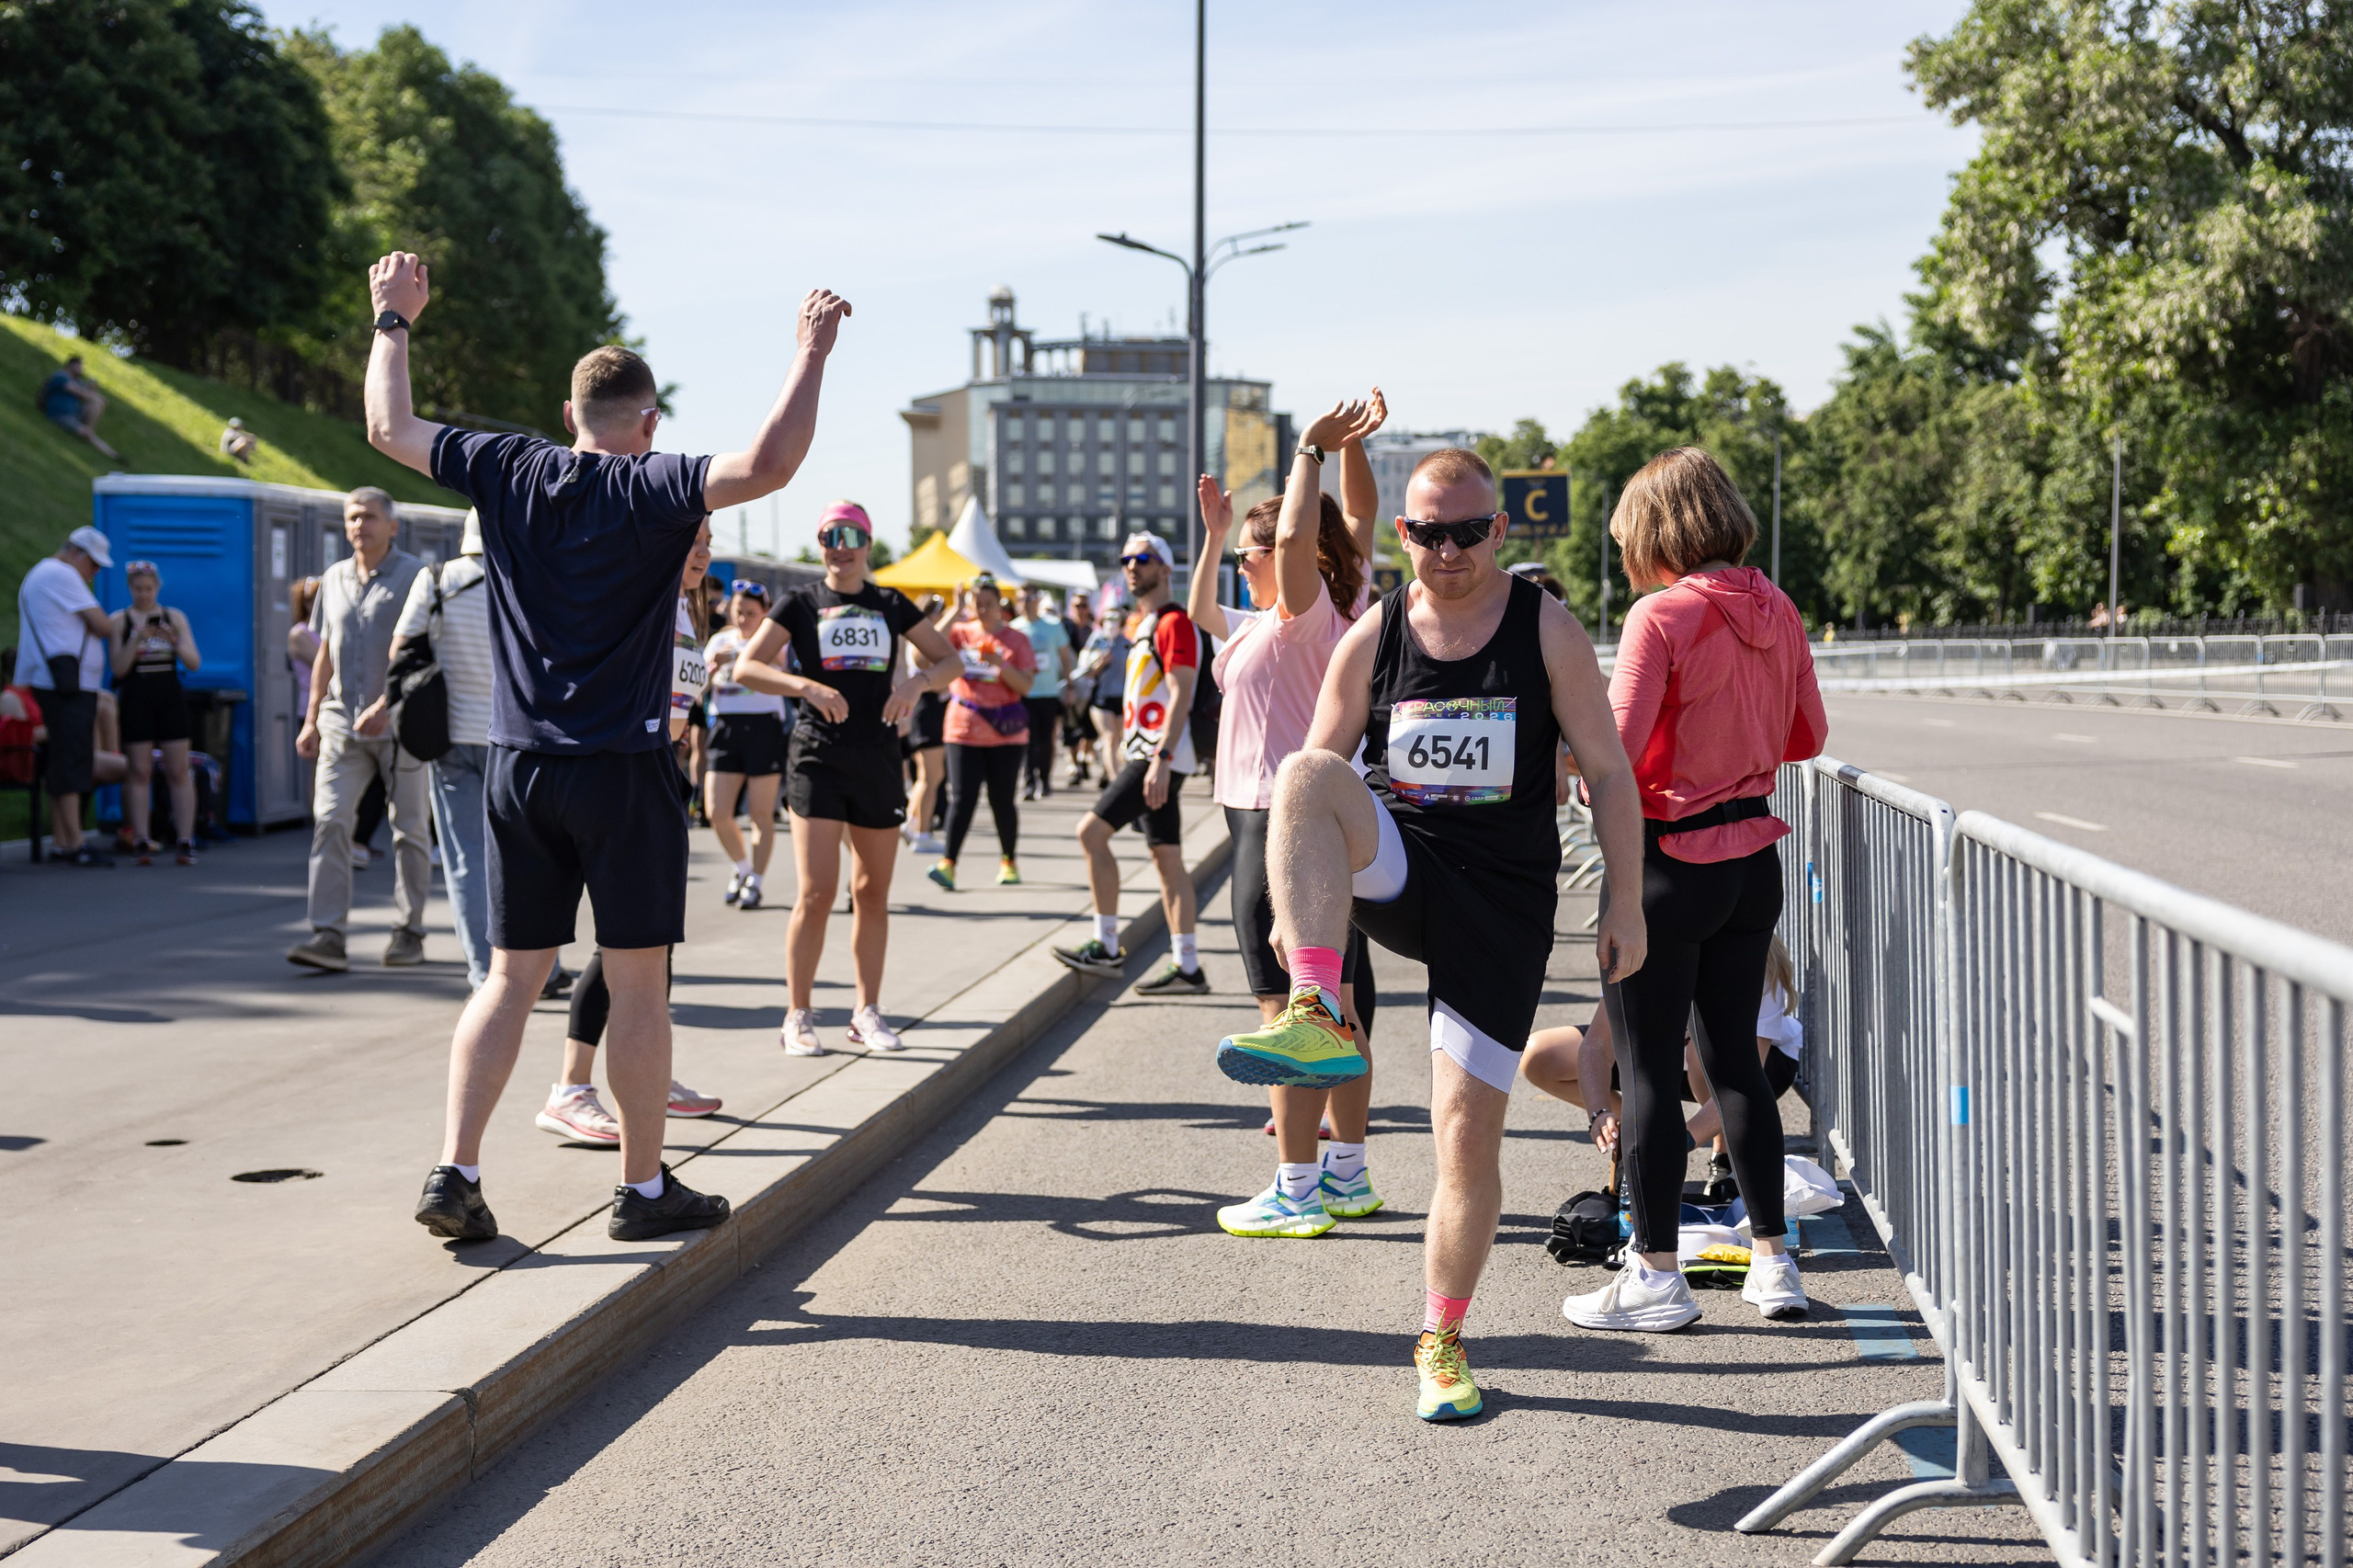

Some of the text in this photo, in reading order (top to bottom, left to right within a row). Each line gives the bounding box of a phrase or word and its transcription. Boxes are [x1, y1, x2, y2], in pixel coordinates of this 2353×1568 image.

[832, 628, 879, 647] 6831
[1460, 711, 1514, 721] 2026
[1407, 734, 1489, 770] 6541
